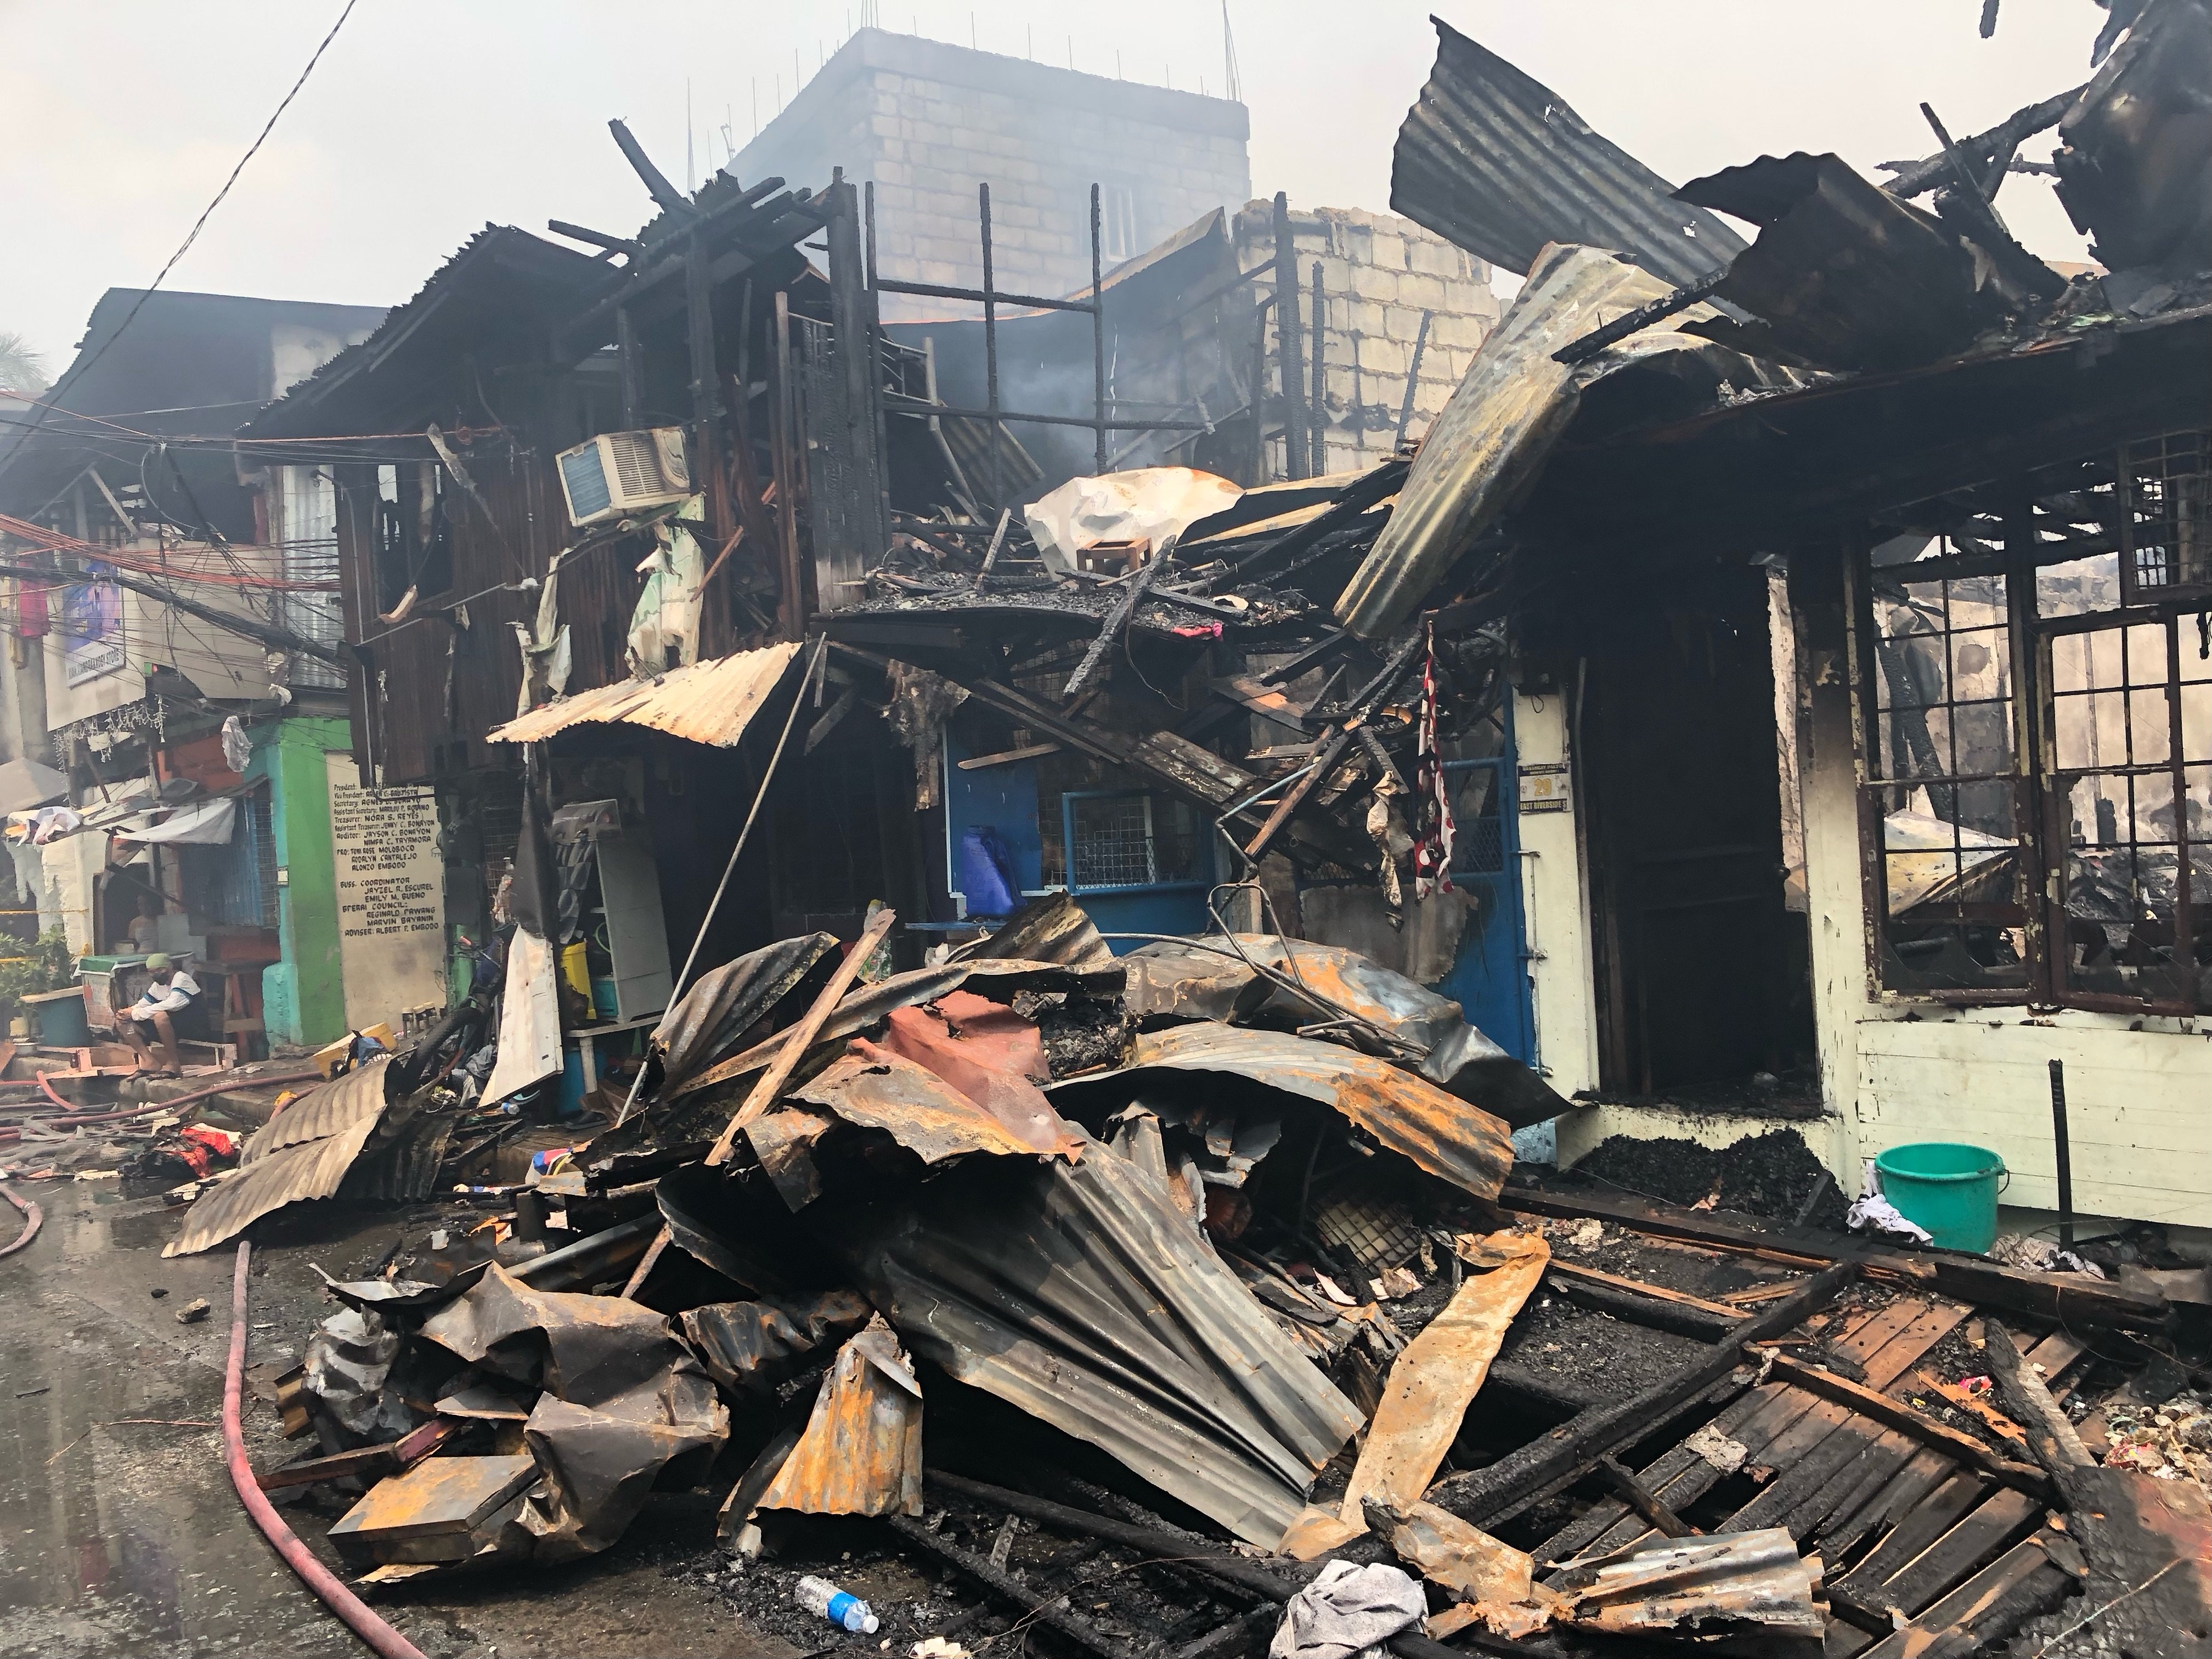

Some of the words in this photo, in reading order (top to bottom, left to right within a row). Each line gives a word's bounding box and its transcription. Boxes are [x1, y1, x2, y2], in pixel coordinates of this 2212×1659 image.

[1534, 778, 1551, 796] 29
[1520, 802, 1533, 810] EAST
[1533, 800, 1561, 809] RIVERSIDE
[395, 836, 431, 844] TAYAMORA
[379, 844, 415, 854] MOLOBOCO
[352, 863, 375, 872] ALONZO
[360, 877, 410, 887] COORDINATOR
[364, 887, 393, 895] JAYZEL
[365, 894, 388, 903] EMILY
[372, 902, 408, 910] COUNCIL:
[366, 910, 400, 918] REGINALD
[366, 918, 397, 927] MARVIN
[376, 926, 401, 934] ALBERT
